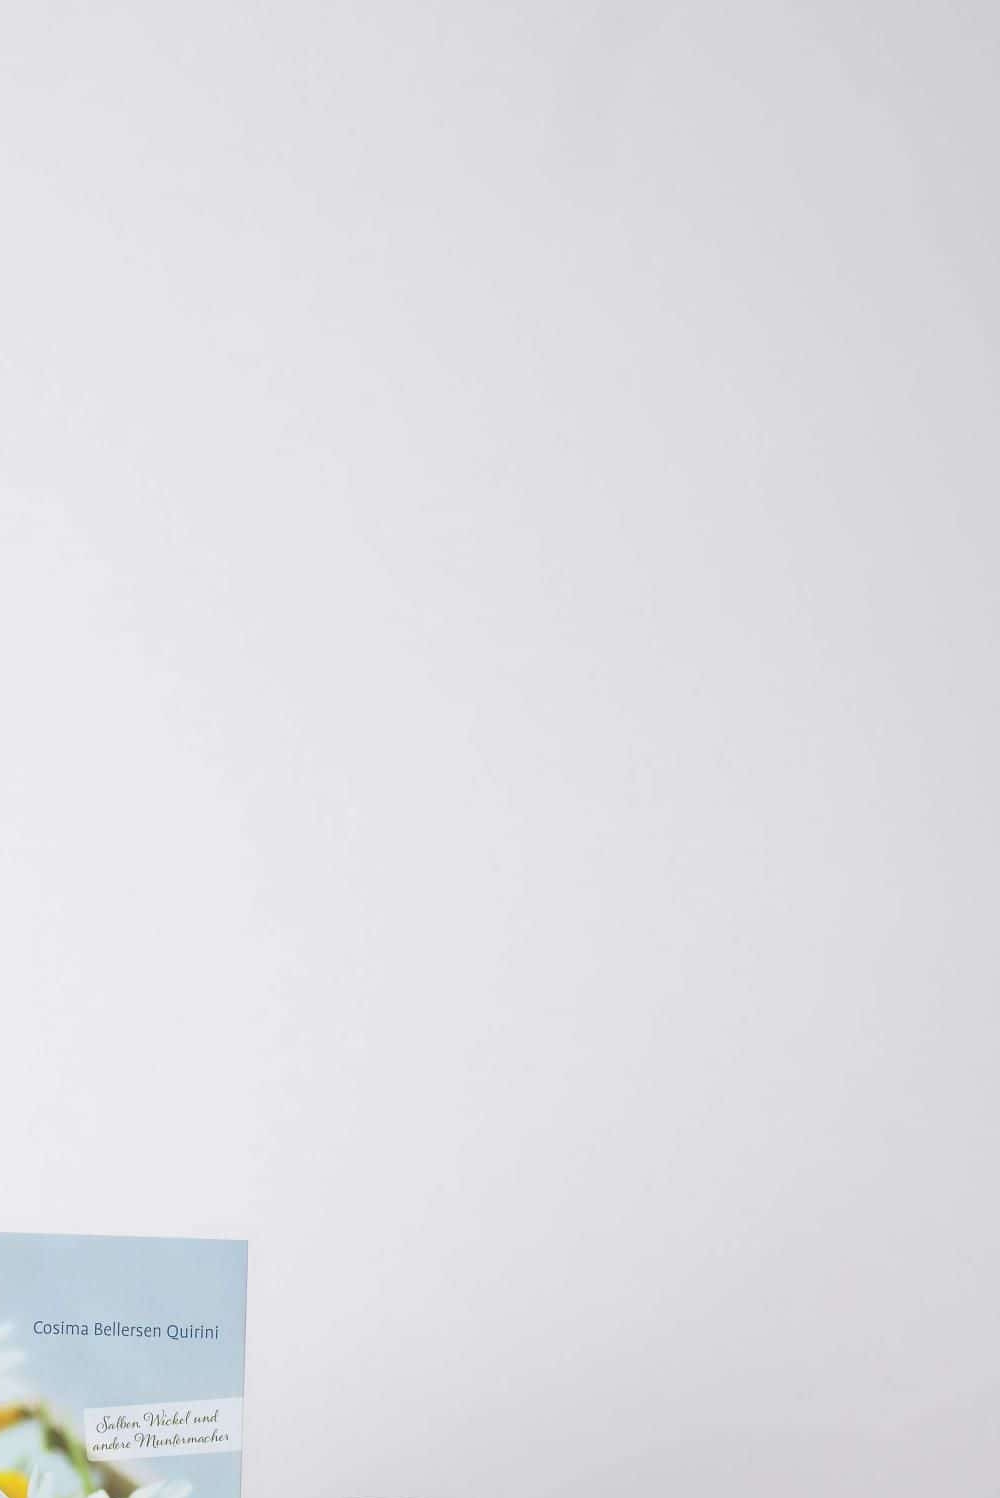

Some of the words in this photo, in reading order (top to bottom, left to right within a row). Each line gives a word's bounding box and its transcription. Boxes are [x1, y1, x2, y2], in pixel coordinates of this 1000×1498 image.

[33, 1320, 89, 1336] Cosima
[94, 1322, 162, 1338] Bellersen
[167, 1324, 220, 1341] Quirini
[143, 1409, 192, 1427] Wickel
[193, 1409, 219, 1424] und
[92, 1436, 131, 1452] andere
[134, 1428, 230, 1449] Muntermacher
